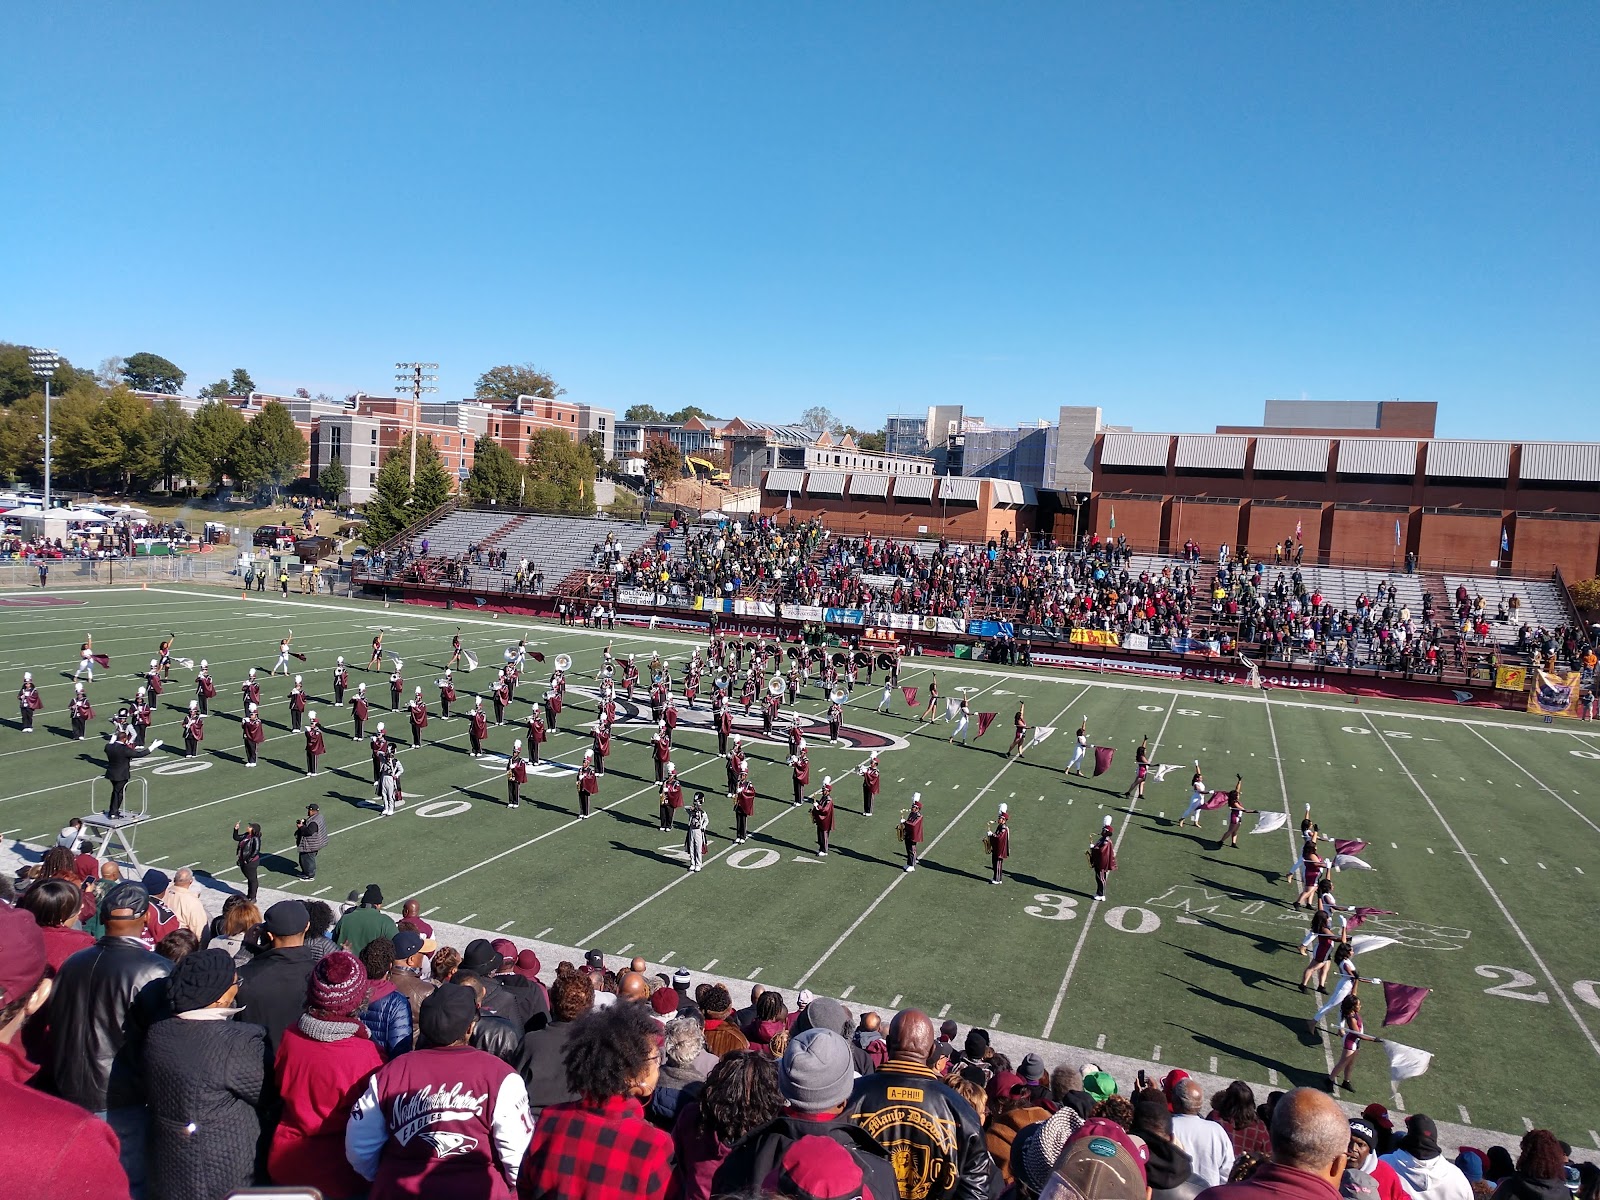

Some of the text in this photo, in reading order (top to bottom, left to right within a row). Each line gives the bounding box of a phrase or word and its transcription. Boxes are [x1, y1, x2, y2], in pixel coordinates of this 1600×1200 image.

[720, 621, 791, 635] University
[402, 1113, 442, 1141] EAGLES
[868, 1109, 905, 1136] Manly
